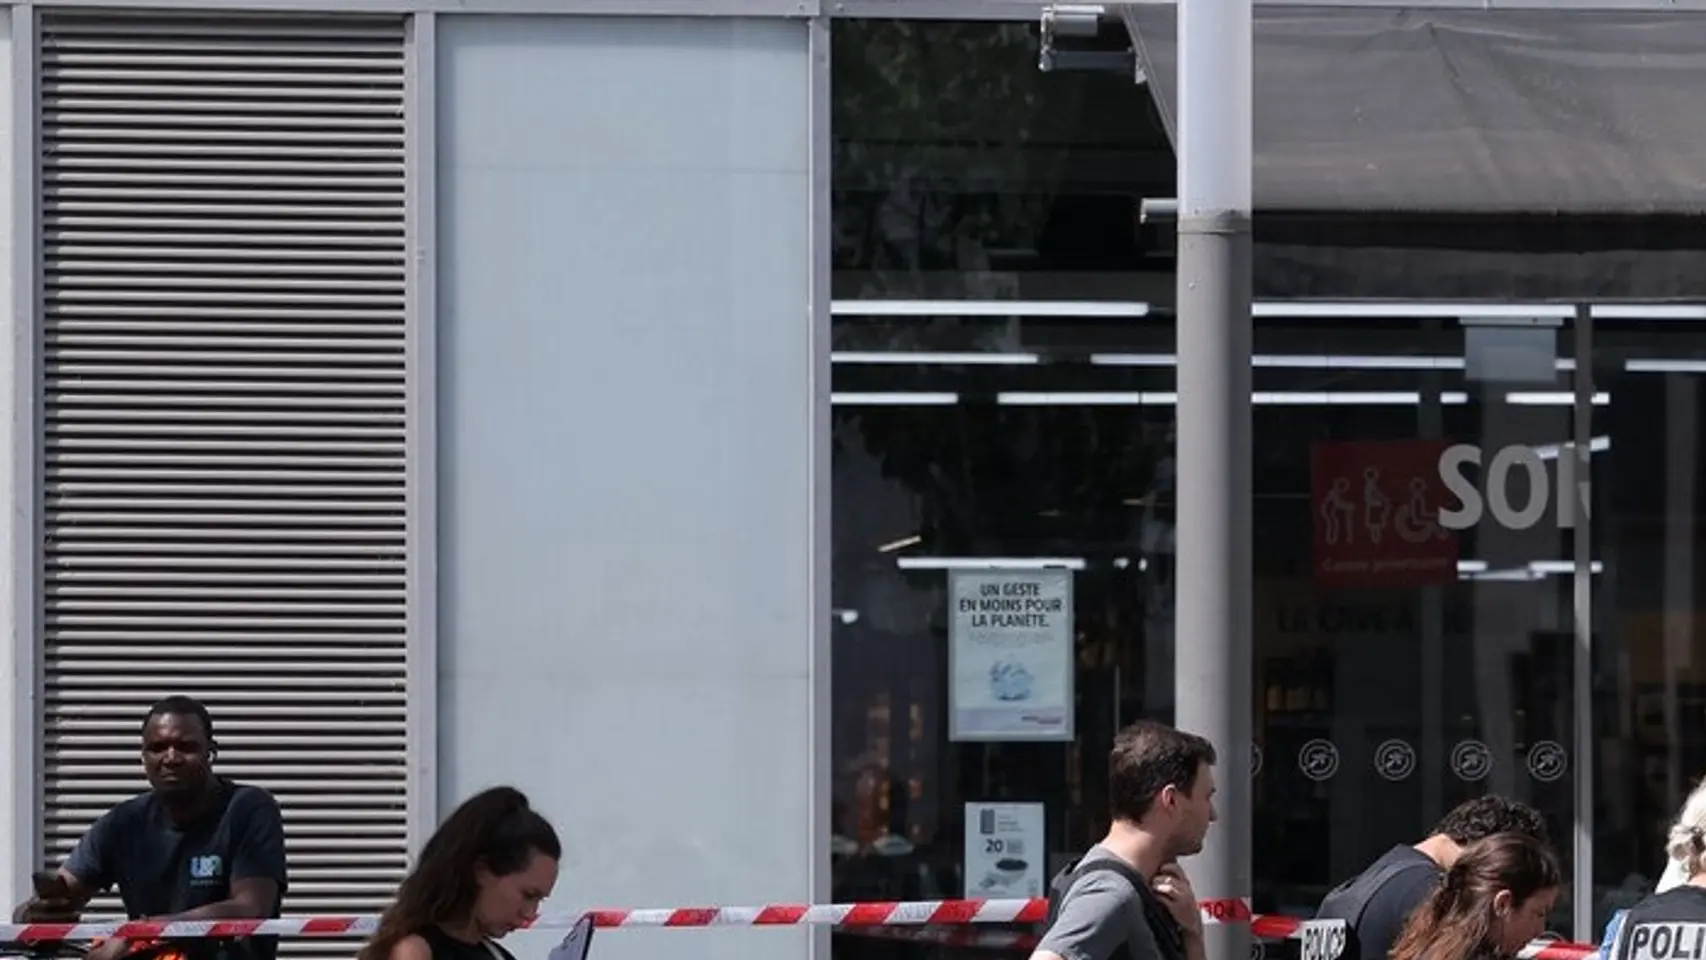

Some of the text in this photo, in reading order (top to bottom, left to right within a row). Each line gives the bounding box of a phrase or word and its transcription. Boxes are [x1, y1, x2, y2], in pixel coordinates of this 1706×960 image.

[980, 582, 1041, 596] UN GESTE
[960, 599, 1062, 612] EN MOINS POUR
[972, 614, 988, 627] LA
